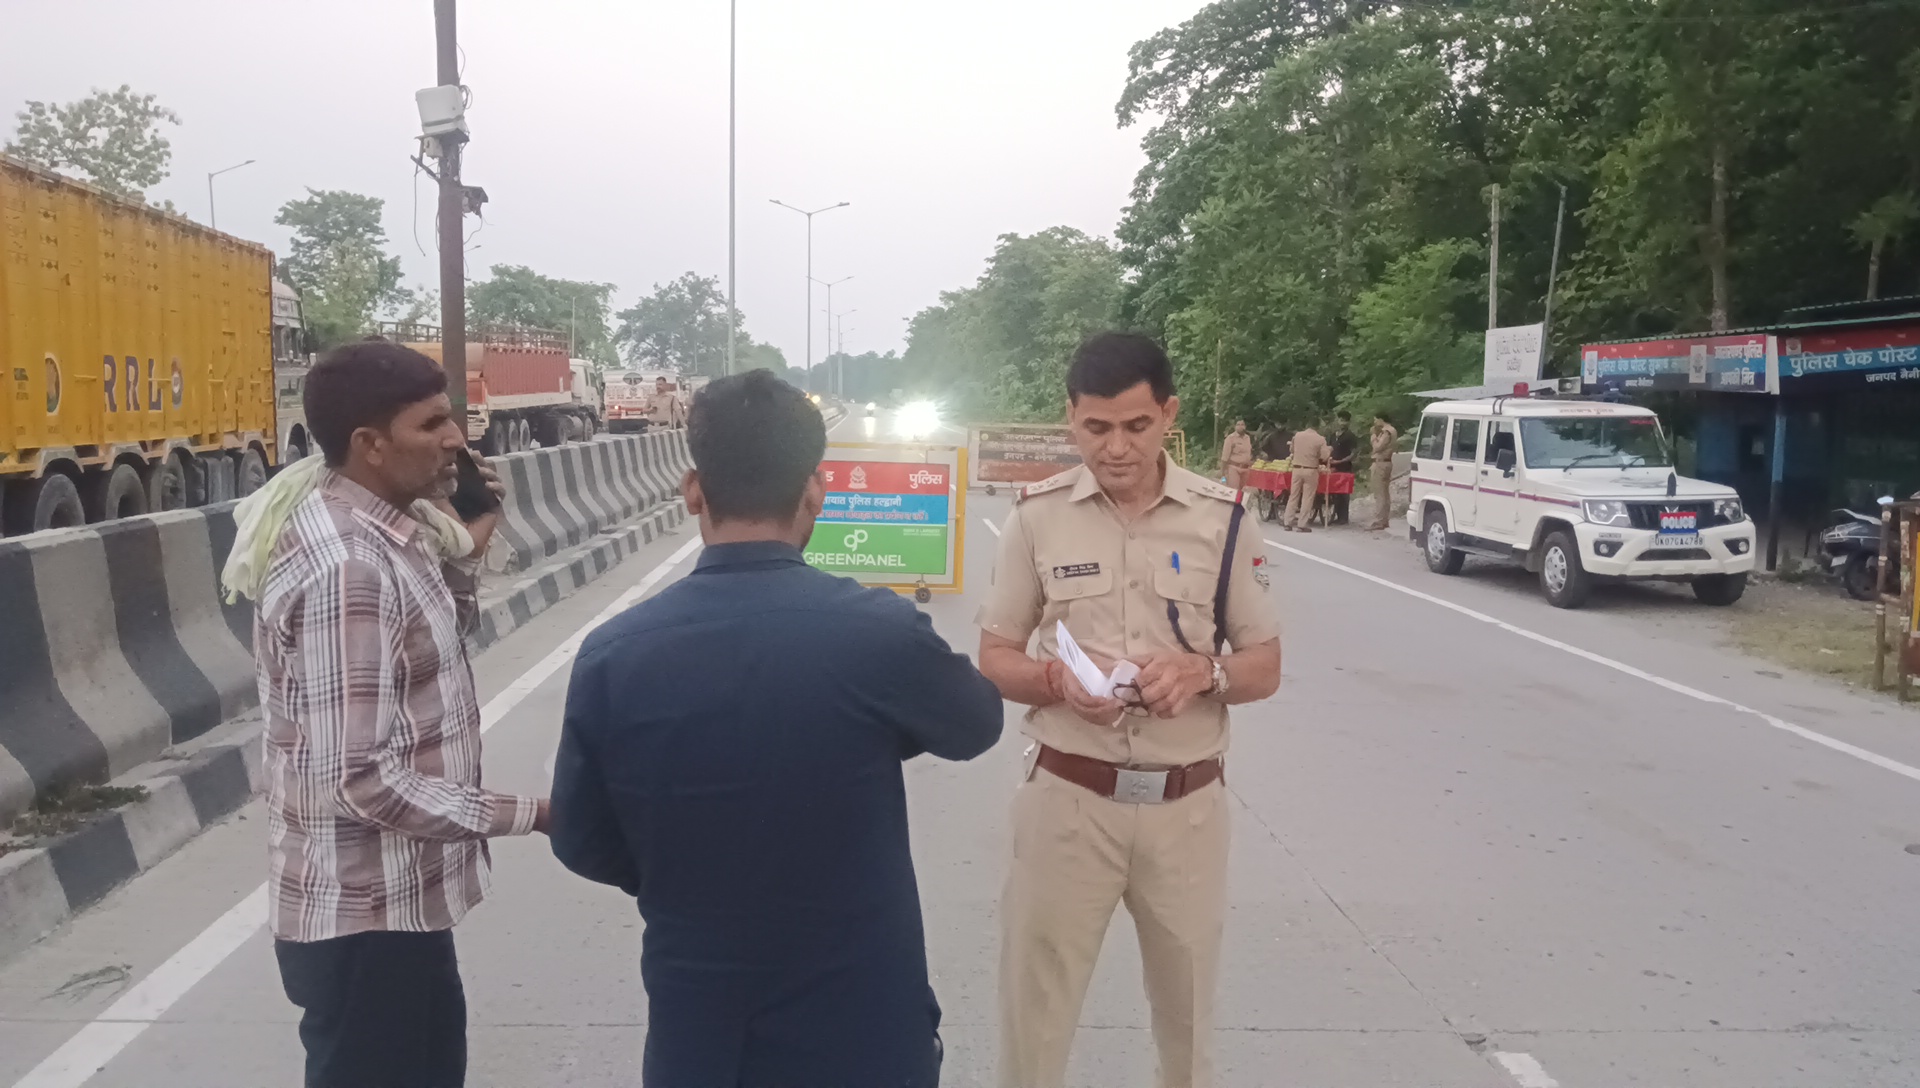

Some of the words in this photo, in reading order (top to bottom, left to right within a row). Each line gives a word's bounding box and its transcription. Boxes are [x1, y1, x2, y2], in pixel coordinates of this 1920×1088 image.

[1789, 351, 1838, 377] पुलिस
[1843, 347, 1873, 367] चेक
[1877, 344, 1918, 363] पोस्ट
[1865, 372, 1897, 382] जनपद
[1900, 367, 1920, 380] नैनी
[909, 470, 943, 488] पुलिस
[848, 494, 871, 508] पुलिस
[1661, 516, 1695, 529] POLICE
[803, 552, 906, 567] GREENPANEL
